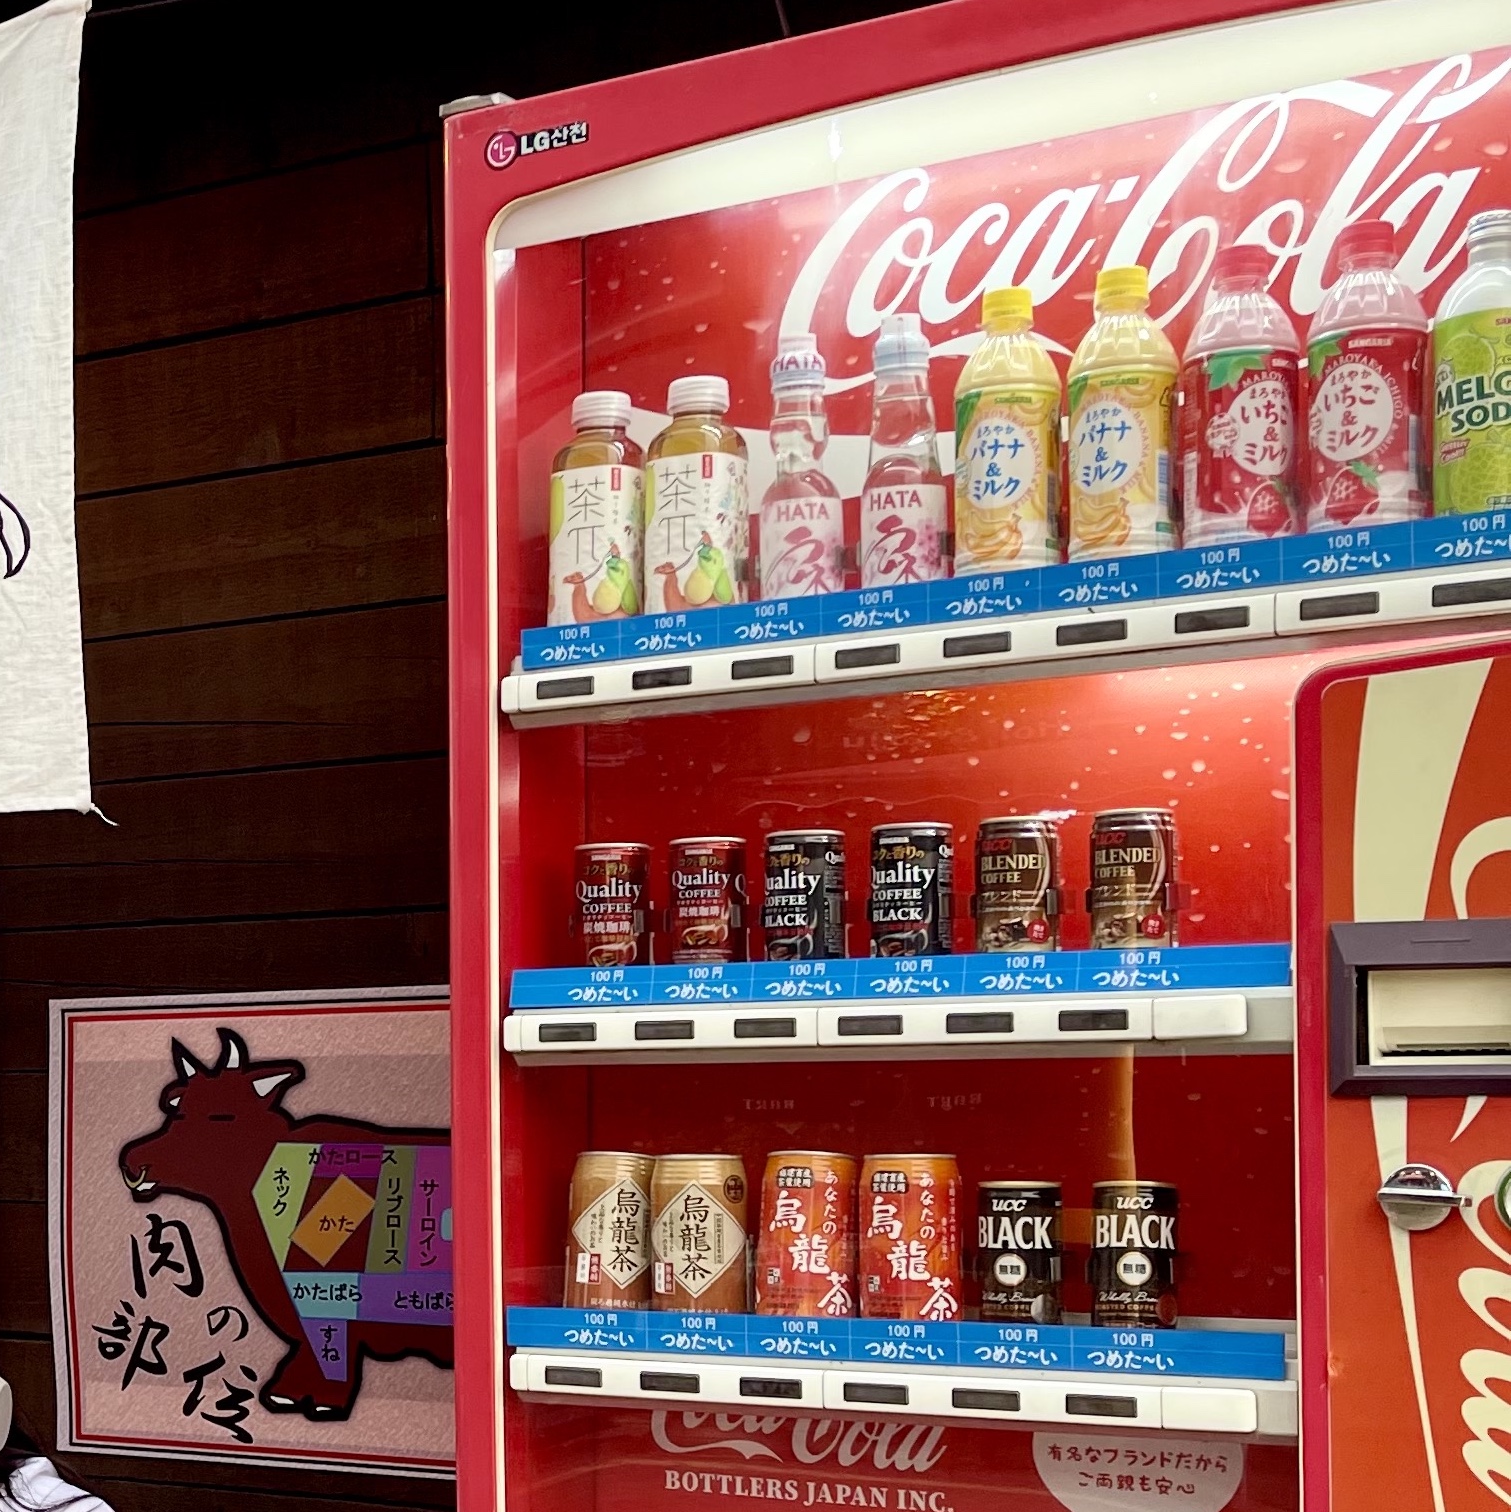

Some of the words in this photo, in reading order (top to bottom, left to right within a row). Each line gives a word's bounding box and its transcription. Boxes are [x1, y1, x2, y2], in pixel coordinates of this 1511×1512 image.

[1324, 384, 1380, 412] いちご
[1341, 410, 1358, 427] &
[1078, 420, 1132, 447] バナナ
[1325, 425, 1379, 453] ミルク
[971, 438, 1025, 461] バナナ
[1095, 446, 1109, 462] &
[986, 462, 1002, 477] &
[1081, 460, 1128, 487] ミルク
[870, 489, 923, 511] HATA
[973, 476, 1021, 501] ミルク
[776, 502, 830, 522] HATA
[981, 853, 1045, 871] BLENDED
[1095, 847, 1161, 865] BLENDED
[672, 868, 731, 890] Quality
[765, 868, 821, 896] uality
[981, 871, 1022, 884] COFFEE
[1094, 865, 1136, 878] COFFEE
[575, 877, 643, 903] Quality
[679, 889, 721, 899] COFFEE
[873, 888, 923, 902] COFFEE
[583, 903, 632, 914] COFFEE
[873, 908, 923, 922] BLACK
[308, 1147, 398, 1167] かたロース
[272, 1167, 290, 1217] ネック
[823, 1169, 838, 1236] あなたの
[919, 1173, 936, 1240] あなたの
[318, 1215, 355, 1233] かた
[385, 1177, 402, 1266] リブロース
[419, 1178, 439, 1267] サーロイン
[606, 1187, 641, 1274] 烏龍茶
[978, 1215, 1053, 1249] BLACK
[1095, 1214, 1175, 1250] BLACK
[678, 1194, 713, 1282] 烏龍茶
[769, 1189, 853, 1317] 烏龍茶
[867, 1195, 959, 1322] 烏龍茶
[293, 1283, 363, 1302] かたばら
[320, 1325, 341, 1363] すね
[665, 1469, 799, 1502] BOTTLERS
[803, 1480, 888, 1509] JAPAN
[1078, 1471, 1195, 1495] ご両親も安心
